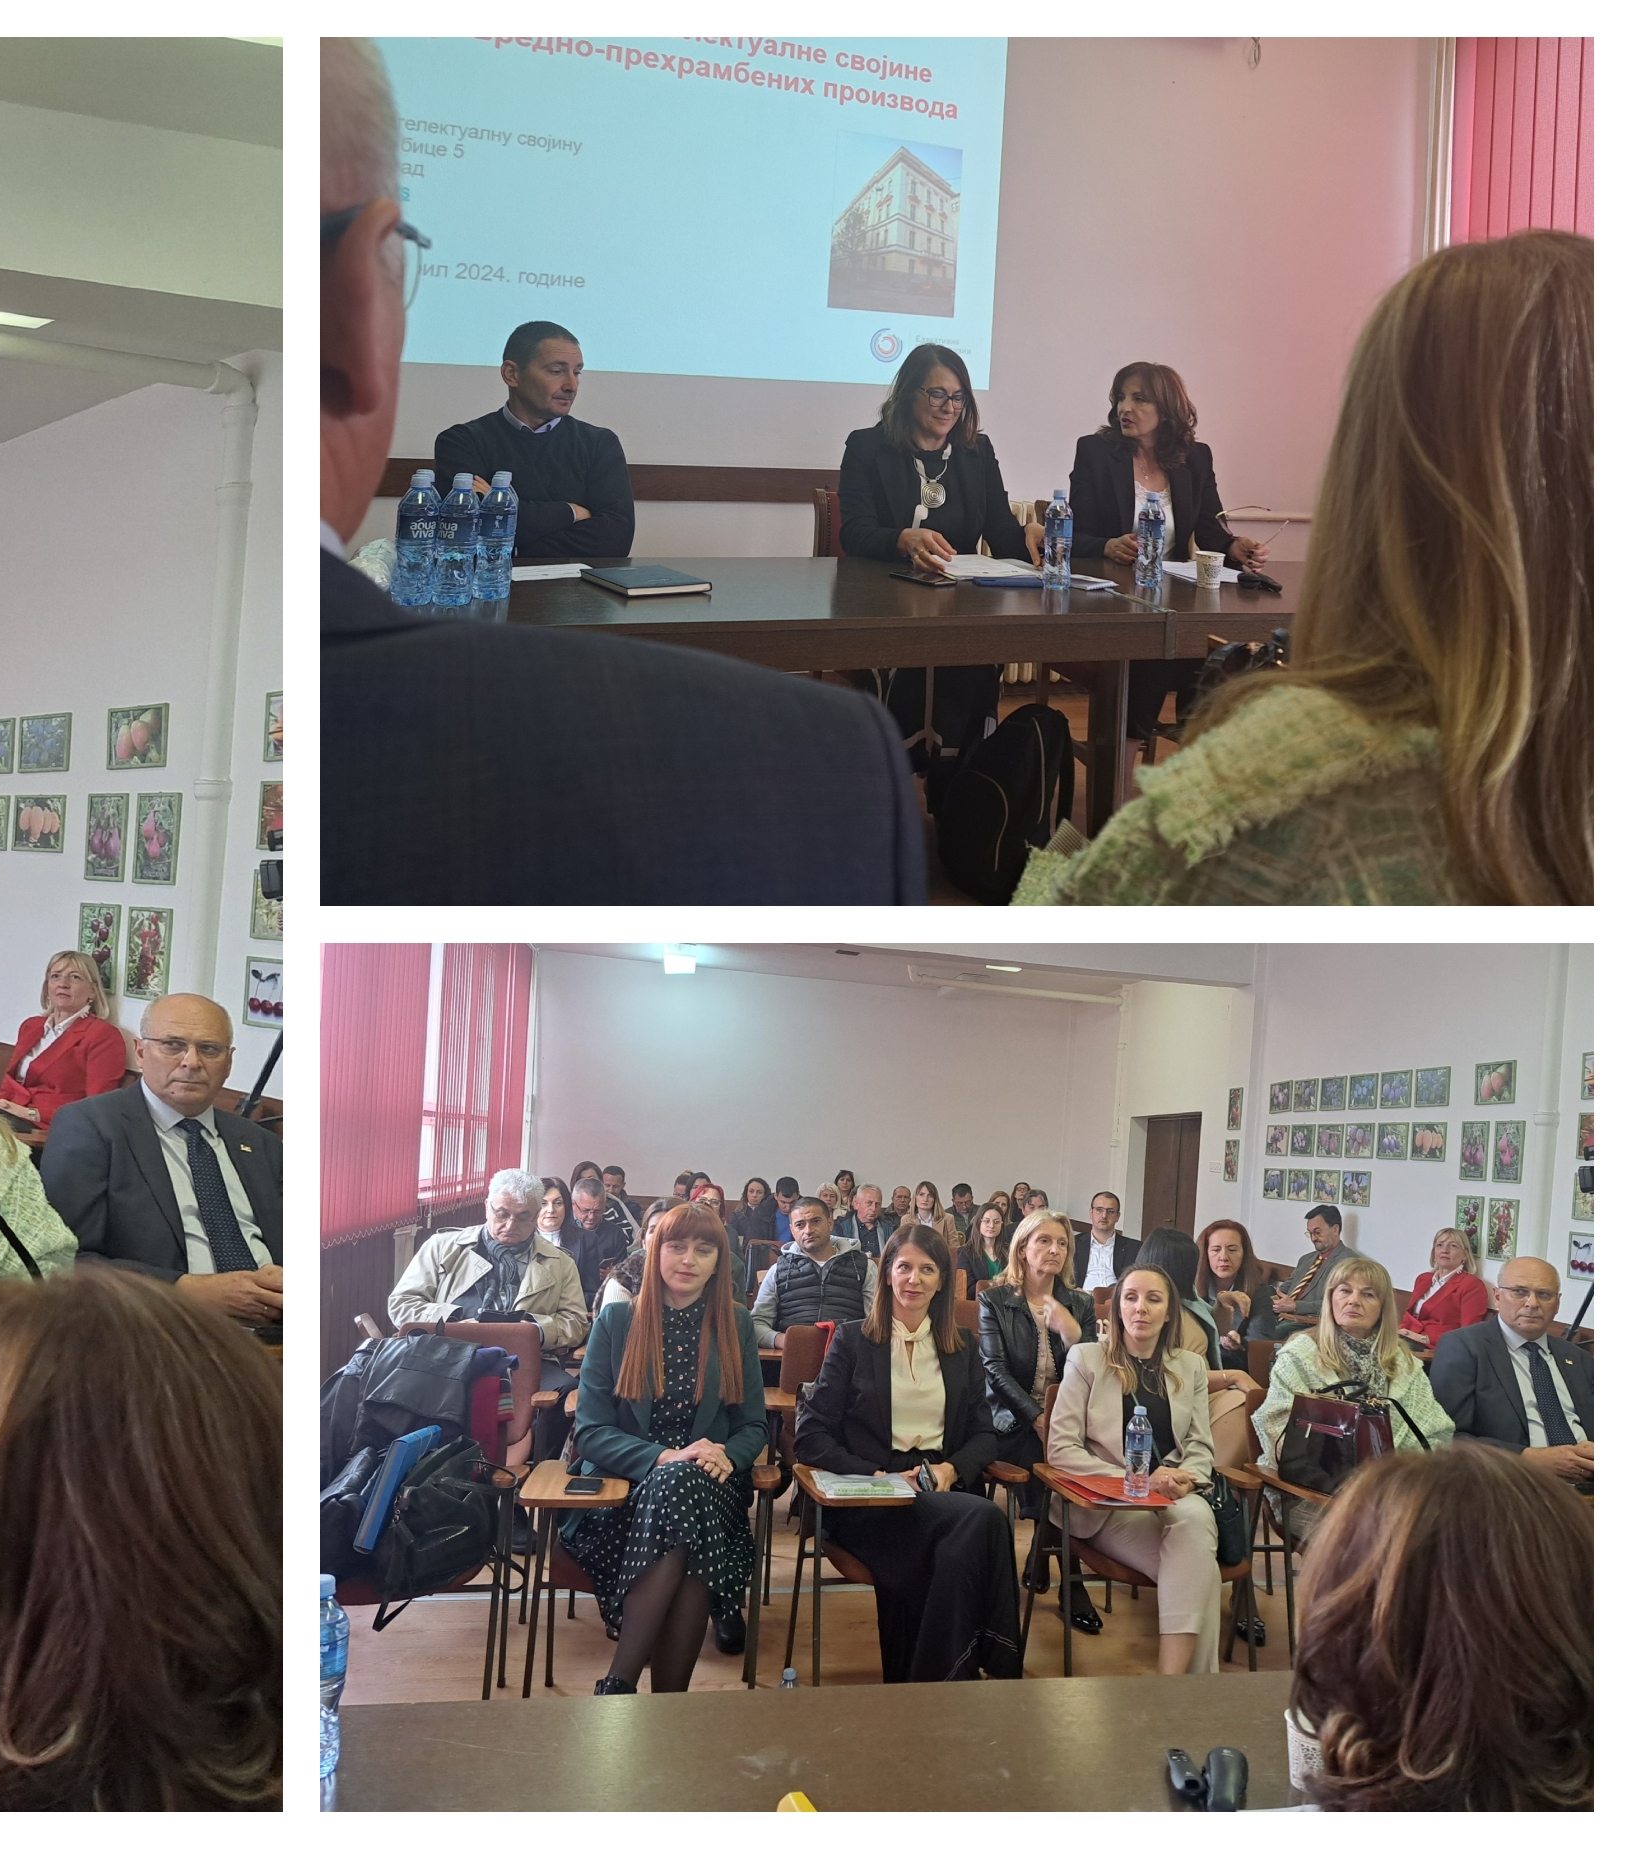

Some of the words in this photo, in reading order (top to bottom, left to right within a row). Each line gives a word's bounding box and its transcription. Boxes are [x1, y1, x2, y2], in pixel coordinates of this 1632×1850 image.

[474, 37, 815, 96] редно-прехрамбених
[823, 81, 958, 120] производа
[835, 51, 932, 83] својине
[453, 143, 465, 159] 5
[517, 132, 583, 156] својину
[454, 262, 511, 283] 2024.
[518, 271, 586, 289] године
